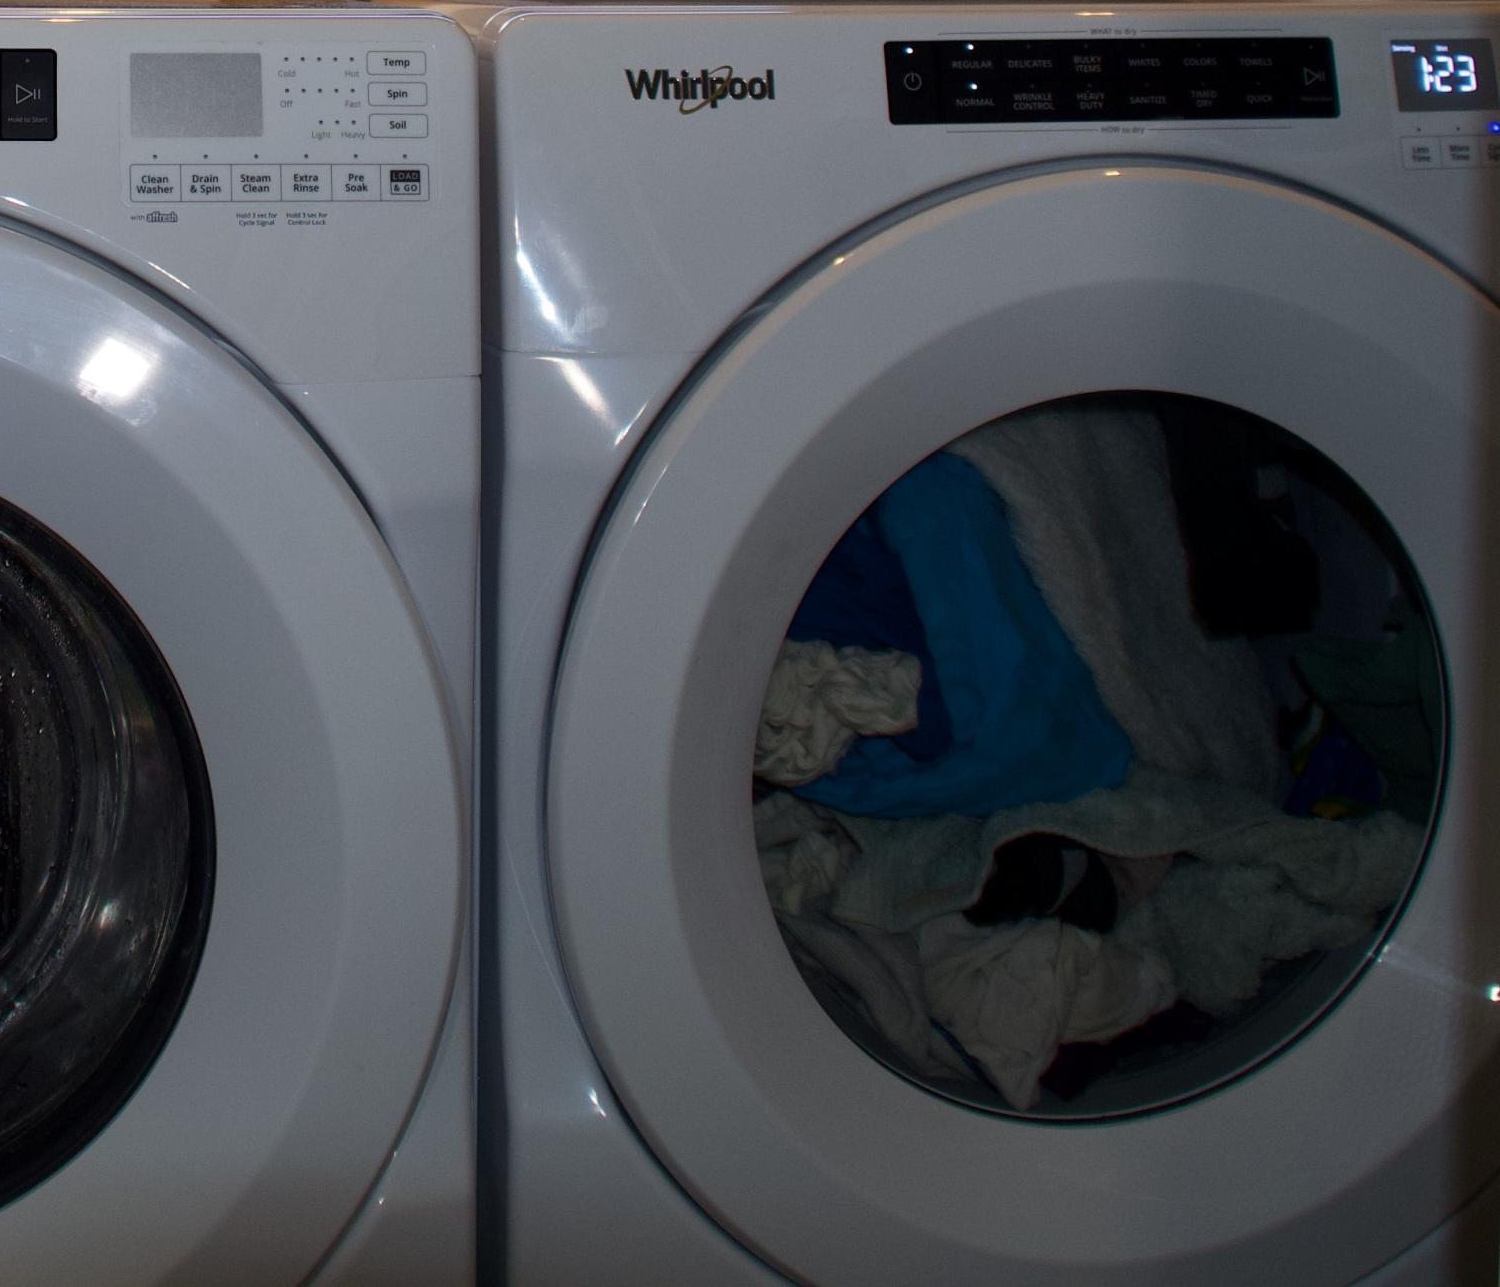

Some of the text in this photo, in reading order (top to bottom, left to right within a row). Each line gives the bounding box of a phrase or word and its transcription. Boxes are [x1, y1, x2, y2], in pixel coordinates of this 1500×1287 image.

[383, 58, 410, 68] Temp
[1008, 59, 1053, 68] DELICATES
[1073, 55, 1102, 64] BULKY
[1127, 58, 1161, 67] WHITES
[1183, 57, 1218, 66] COLORS
[1240, 57, 1273, 66] TOWELS
[952, 60, 993, 69] REGULAR
[1075, 64, 1102, 73] ITEMS
[277, 70, 296, 78] Cold
[345, 70, 360, 78] Hot
[1420, 55, 1477, 92] 1:23
[625, 67, 776, 112] Whirlpool
[387, 89, 408, 100] Spin
[1013, 93, 1052, 101] WRINKLE
[1077, 92, 1104, 100] HEAVY
[1246, 94, 1273, 104] QUICK
[280, 100, 293, 108] Off
[345, 100, 362, 108] Fast
[956, 98, 994, 107] NORMAL
[1129, 96, 1167, 105] SANITIZE
[1013, 102, 1055, 111] CONTROL
[1080, 101, 1103, 110] DUTY
[389, 121, 407, 130] Soil
[311, 130, 331, 140] Light
[341, 131, 366, 140] Heavy
[141, 175, 169, 184] Clean
[192, 174, 219, 183] Drain
[240, 174, 271, 183] Steam
[293, 174, 319, 183] Extra
[348, 174, 364, 183] Pre
[392, 171, 419, 181] LOAD
[136, 185, 174, 194] Washer
[190, 184, 221, 196] & Spin
[242, 184, 270, 193] Clean
[293, 183, 320, 193] Rinse
[345, 183, 368, 193] Soak
[393, 184, 417, 192] & GO
[239, 219, 275, 227] Cycle Signal
